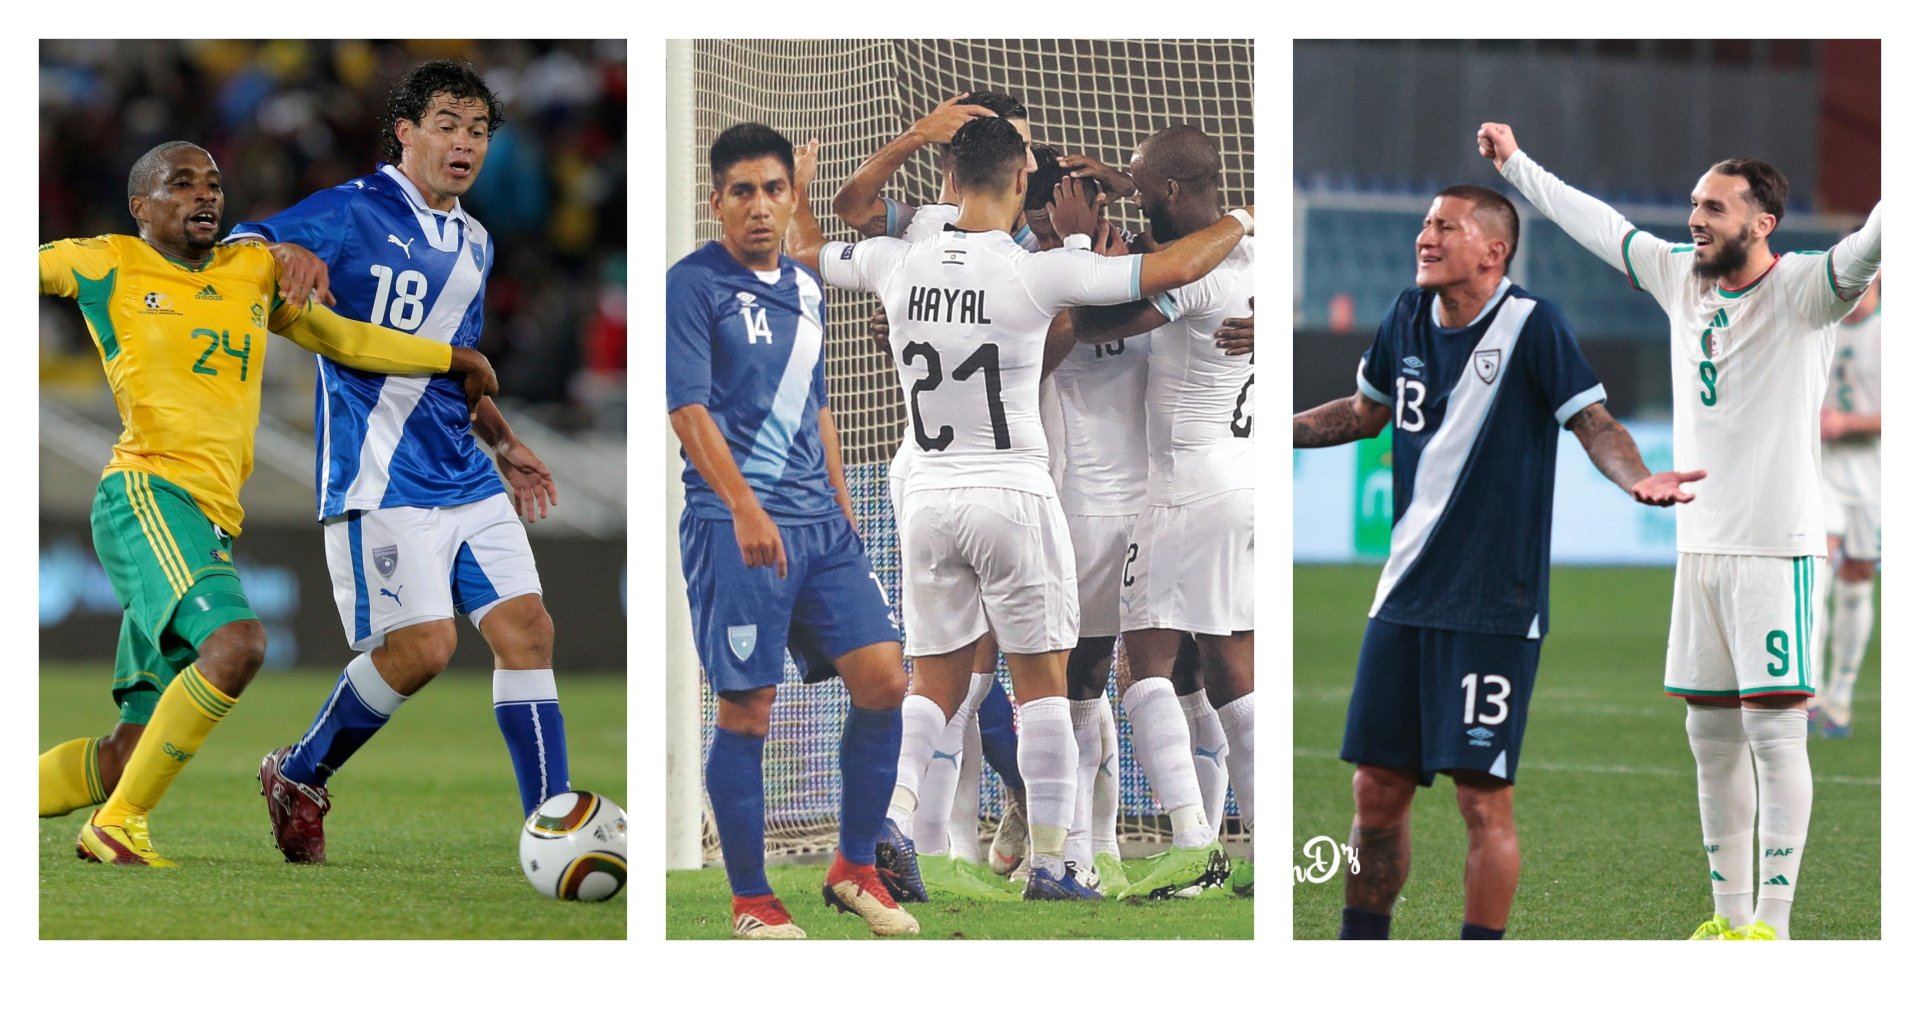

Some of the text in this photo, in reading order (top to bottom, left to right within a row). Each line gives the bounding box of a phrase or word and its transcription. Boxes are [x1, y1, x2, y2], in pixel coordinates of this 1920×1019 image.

[370, 264, 428, 330] 18
[908, 286, 991, 324] KAYAL
[739, 307, 772, 344] 14
[191, 328, 250, 382] 24
[902, 341, 1011, 452] 21
[1396, 376, 1426, 432] 13
[1699, 360, 1717, 406] 9
[1766, 630, 1789, 677] 9
[1461, 673, 1511, 725] 13
[1765, 847, 1794, 857] FAF
